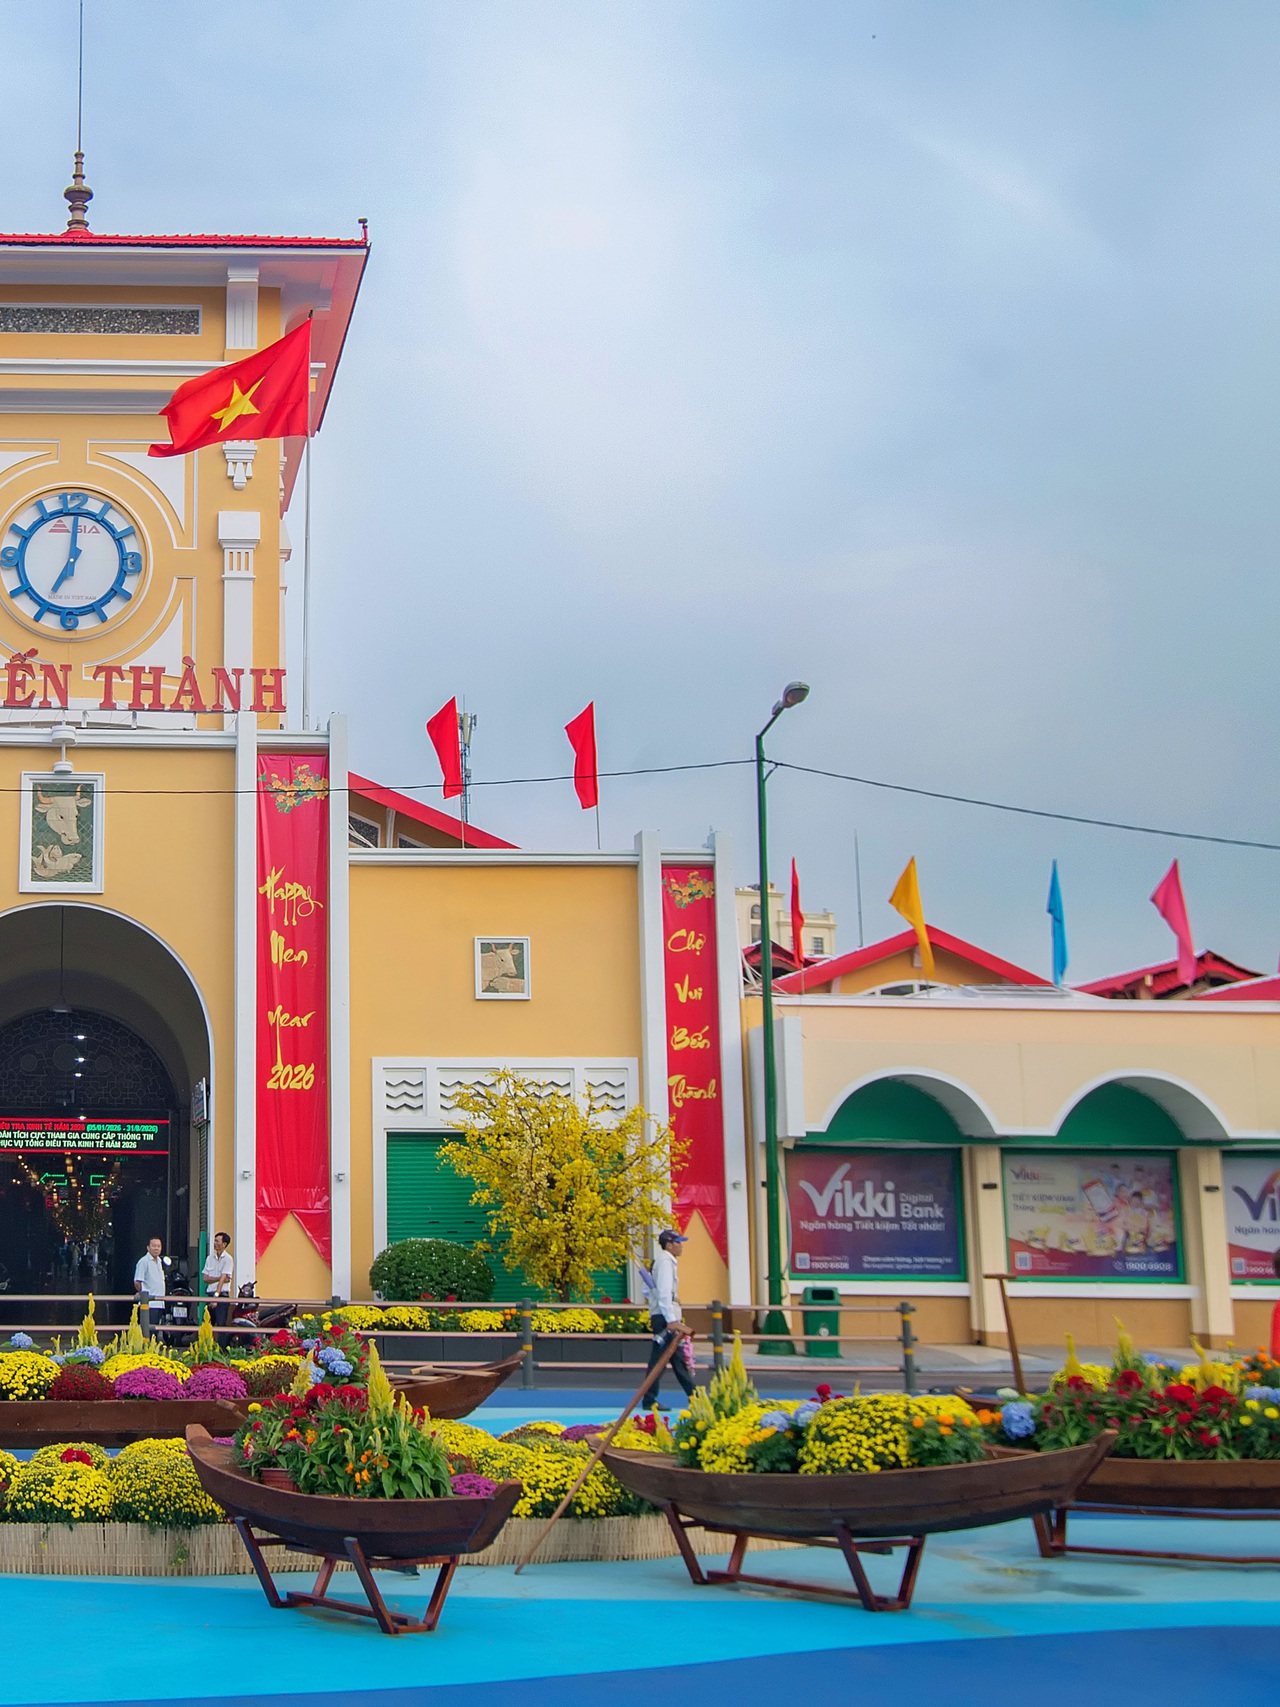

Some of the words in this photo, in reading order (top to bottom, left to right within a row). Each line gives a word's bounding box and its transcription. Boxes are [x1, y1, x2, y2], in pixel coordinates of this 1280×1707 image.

[59, 492, 89, 513] 12
[0, 546, 20, 567] 9
[122, 552, 142, 573] 3
[60, 612, 79, 631] 6
[92, 655, 287, 713] THÀNH
[258, 865, 324, 926] Happy
[667, 928, 706, 956] Chợ
[674, 973, 703, 1003] Vui
[670, 1025, 711, 1051] Bến
[266, 1062, 315, 1090] 2026
[667, 1074, 717, 1108] Thành
[80, 1132, 100, 1140] CUNG
[122, 1141, 137, 1149] 2026
[799, 1163, 896, 1218] Vikki
[900, 1203, 945, 1218] Bank
